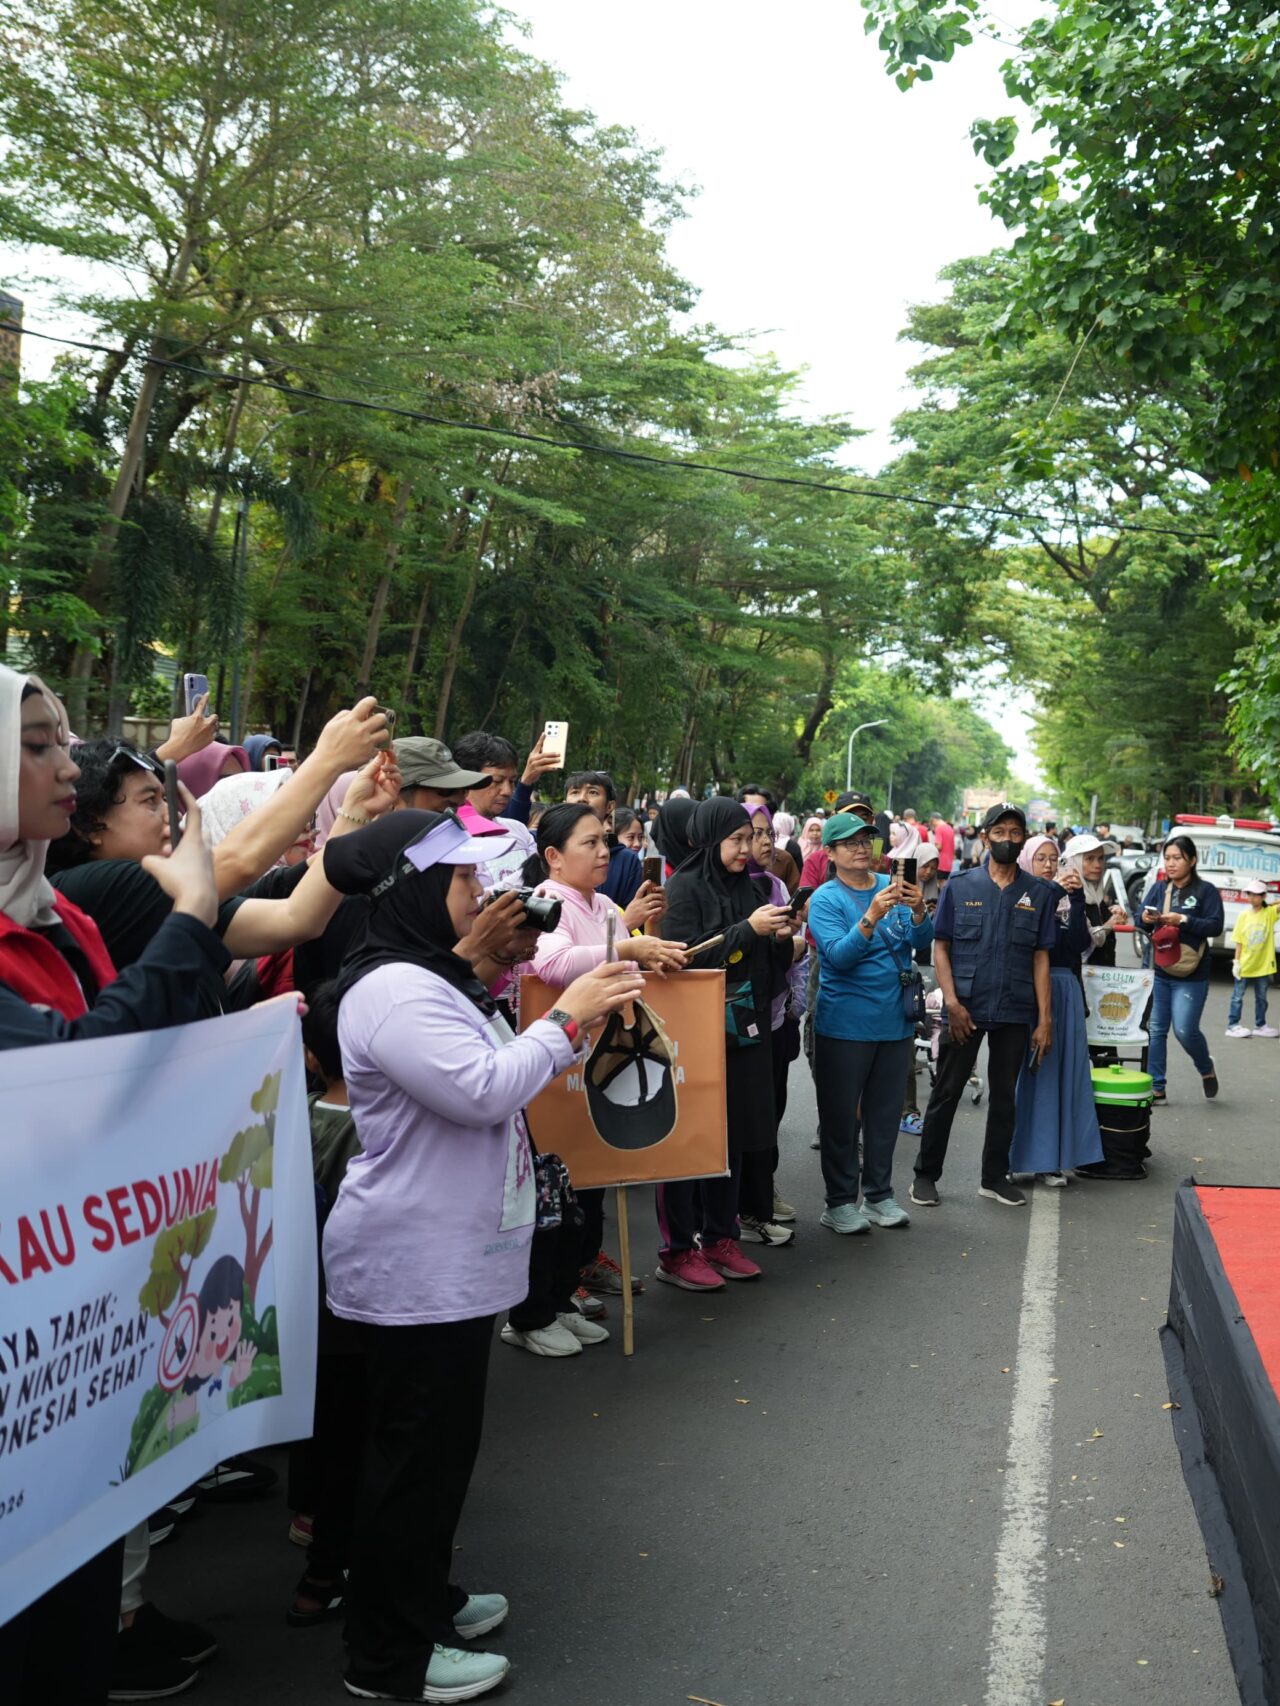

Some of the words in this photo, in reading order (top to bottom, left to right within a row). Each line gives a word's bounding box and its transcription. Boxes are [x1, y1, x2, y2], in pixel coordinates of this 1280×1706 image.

[82, 1157, 219, 1254] SEDUNIA
[17, 1333, 105, 1410] NIKOTIN
[110, 1310, 149, 1360] DAN
[50, 1292, 118, 1351] TARIK:
